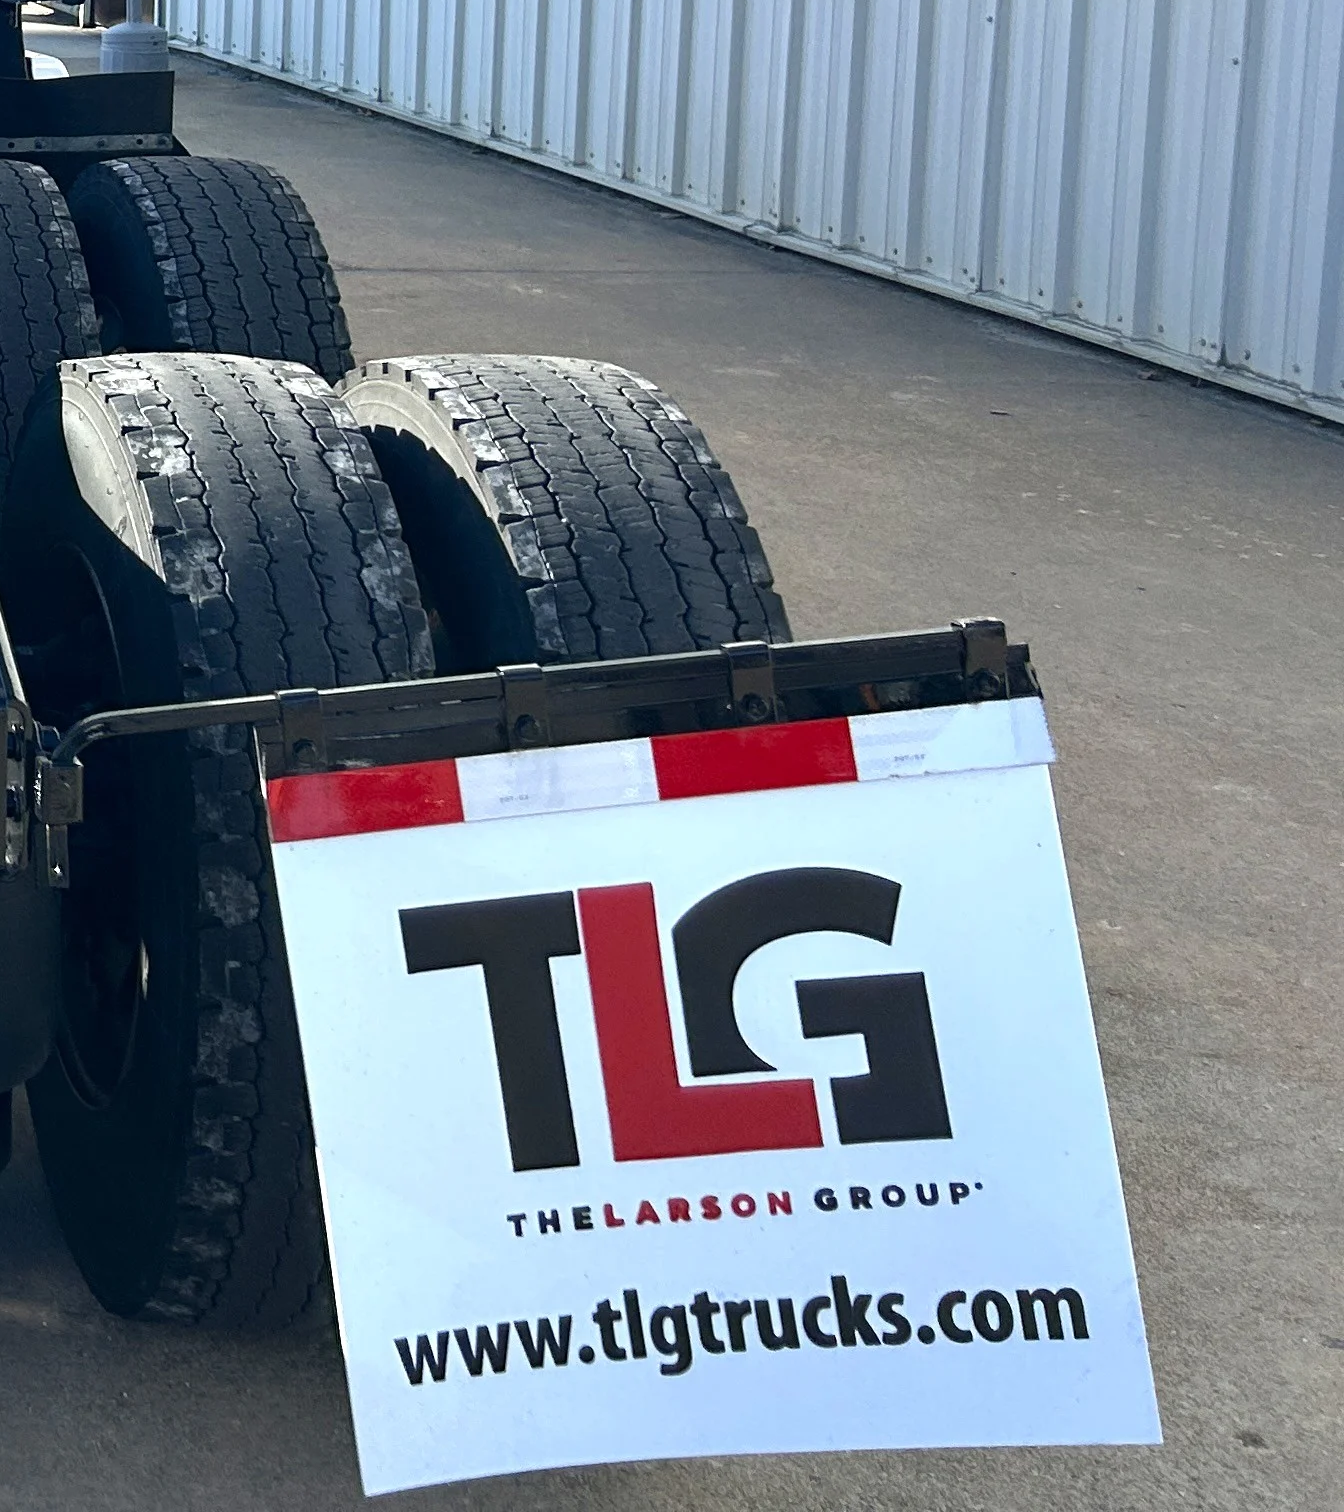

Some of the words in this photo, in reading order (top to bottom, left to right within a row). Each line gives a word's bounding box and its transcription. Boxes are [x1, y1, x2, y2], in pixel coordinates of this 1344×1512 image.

[398, 866, 954, 1173] TLG
[813, 1181, 972, 1212] GROUP
[394, 1275, 1090, 1386] www.tlgtrucks.com
